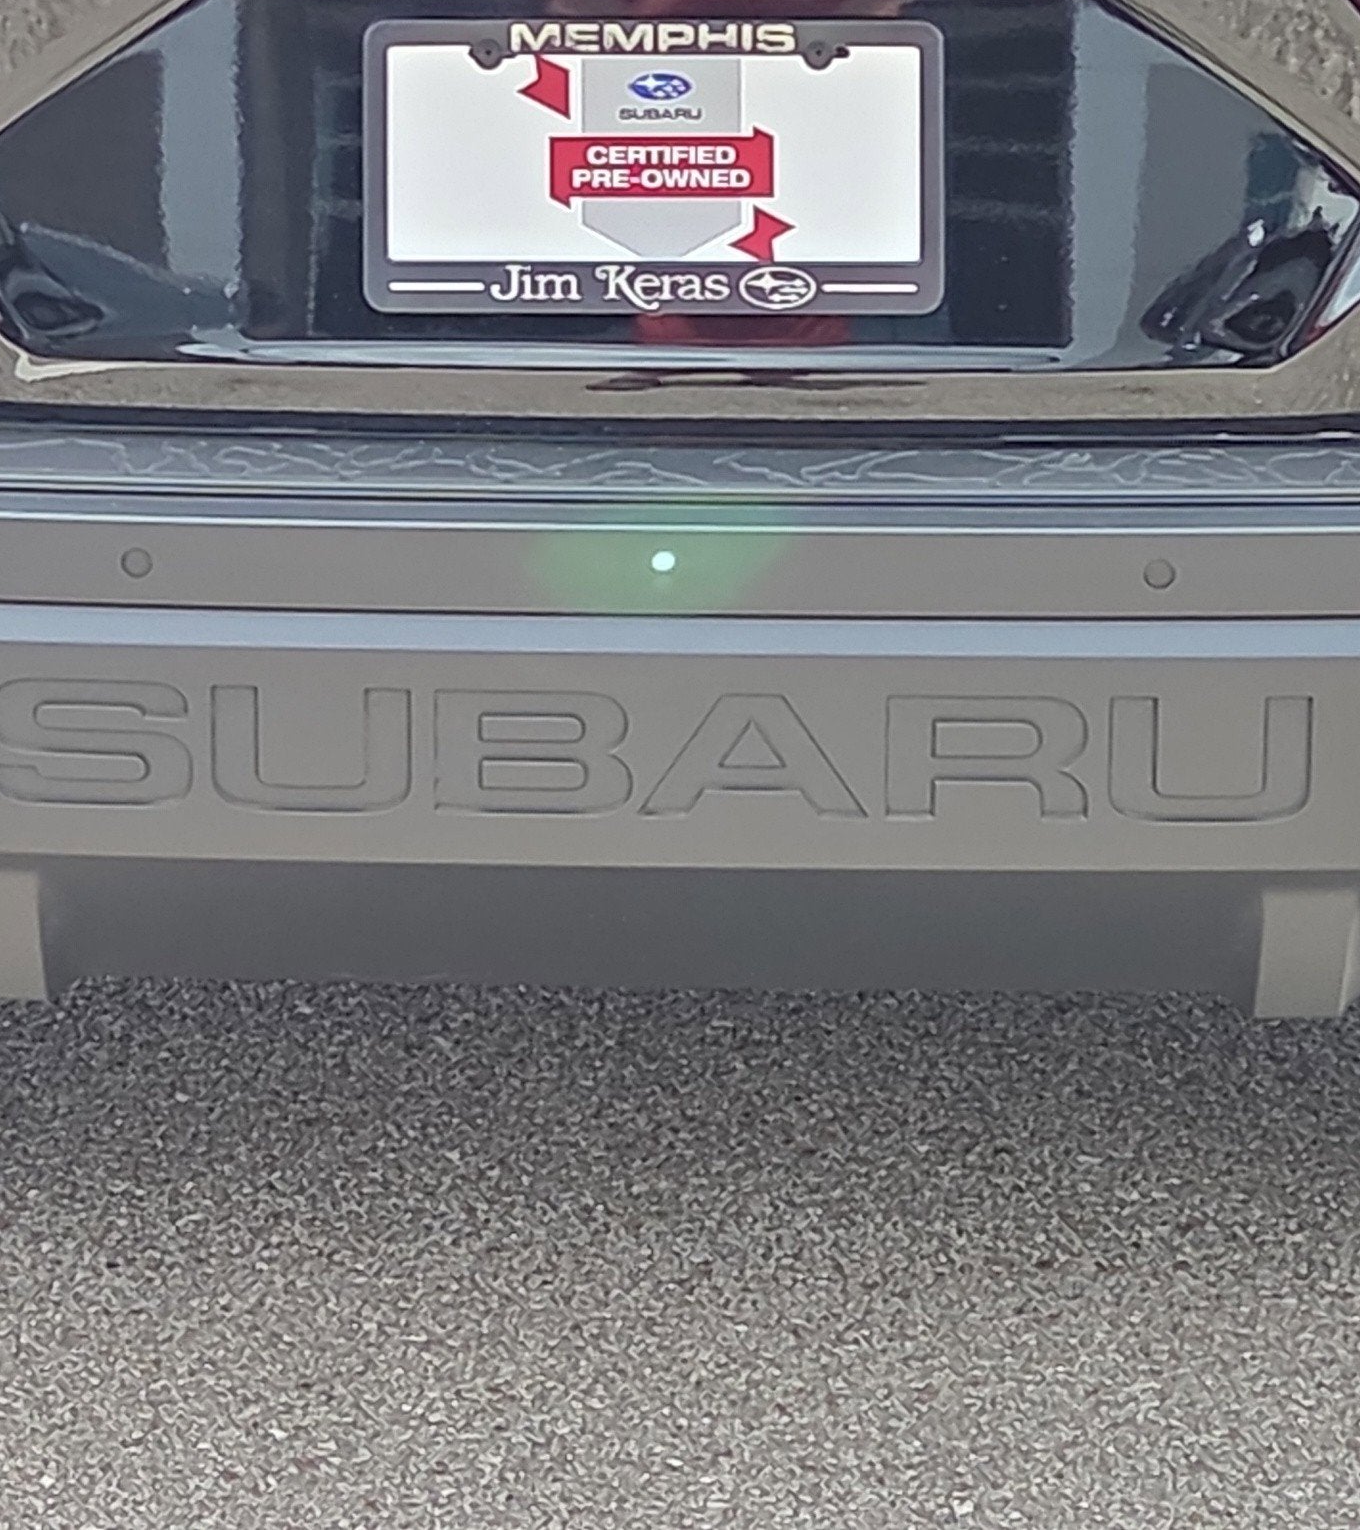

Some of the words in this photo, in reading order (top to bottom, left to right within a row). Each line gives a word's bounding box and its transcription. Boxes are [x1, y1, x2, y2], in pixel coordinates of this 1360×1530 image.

[509, 22, 795, 53] MEMPHIS
[619, 108, 702, 121] SUBARU
[585, 145, 737, 166] CERTIFIED
[571, 168, 751, 190] PRE-OWNED
[489, 266, 582, 303] Jim
[595, 267, 731, 311] Keras
